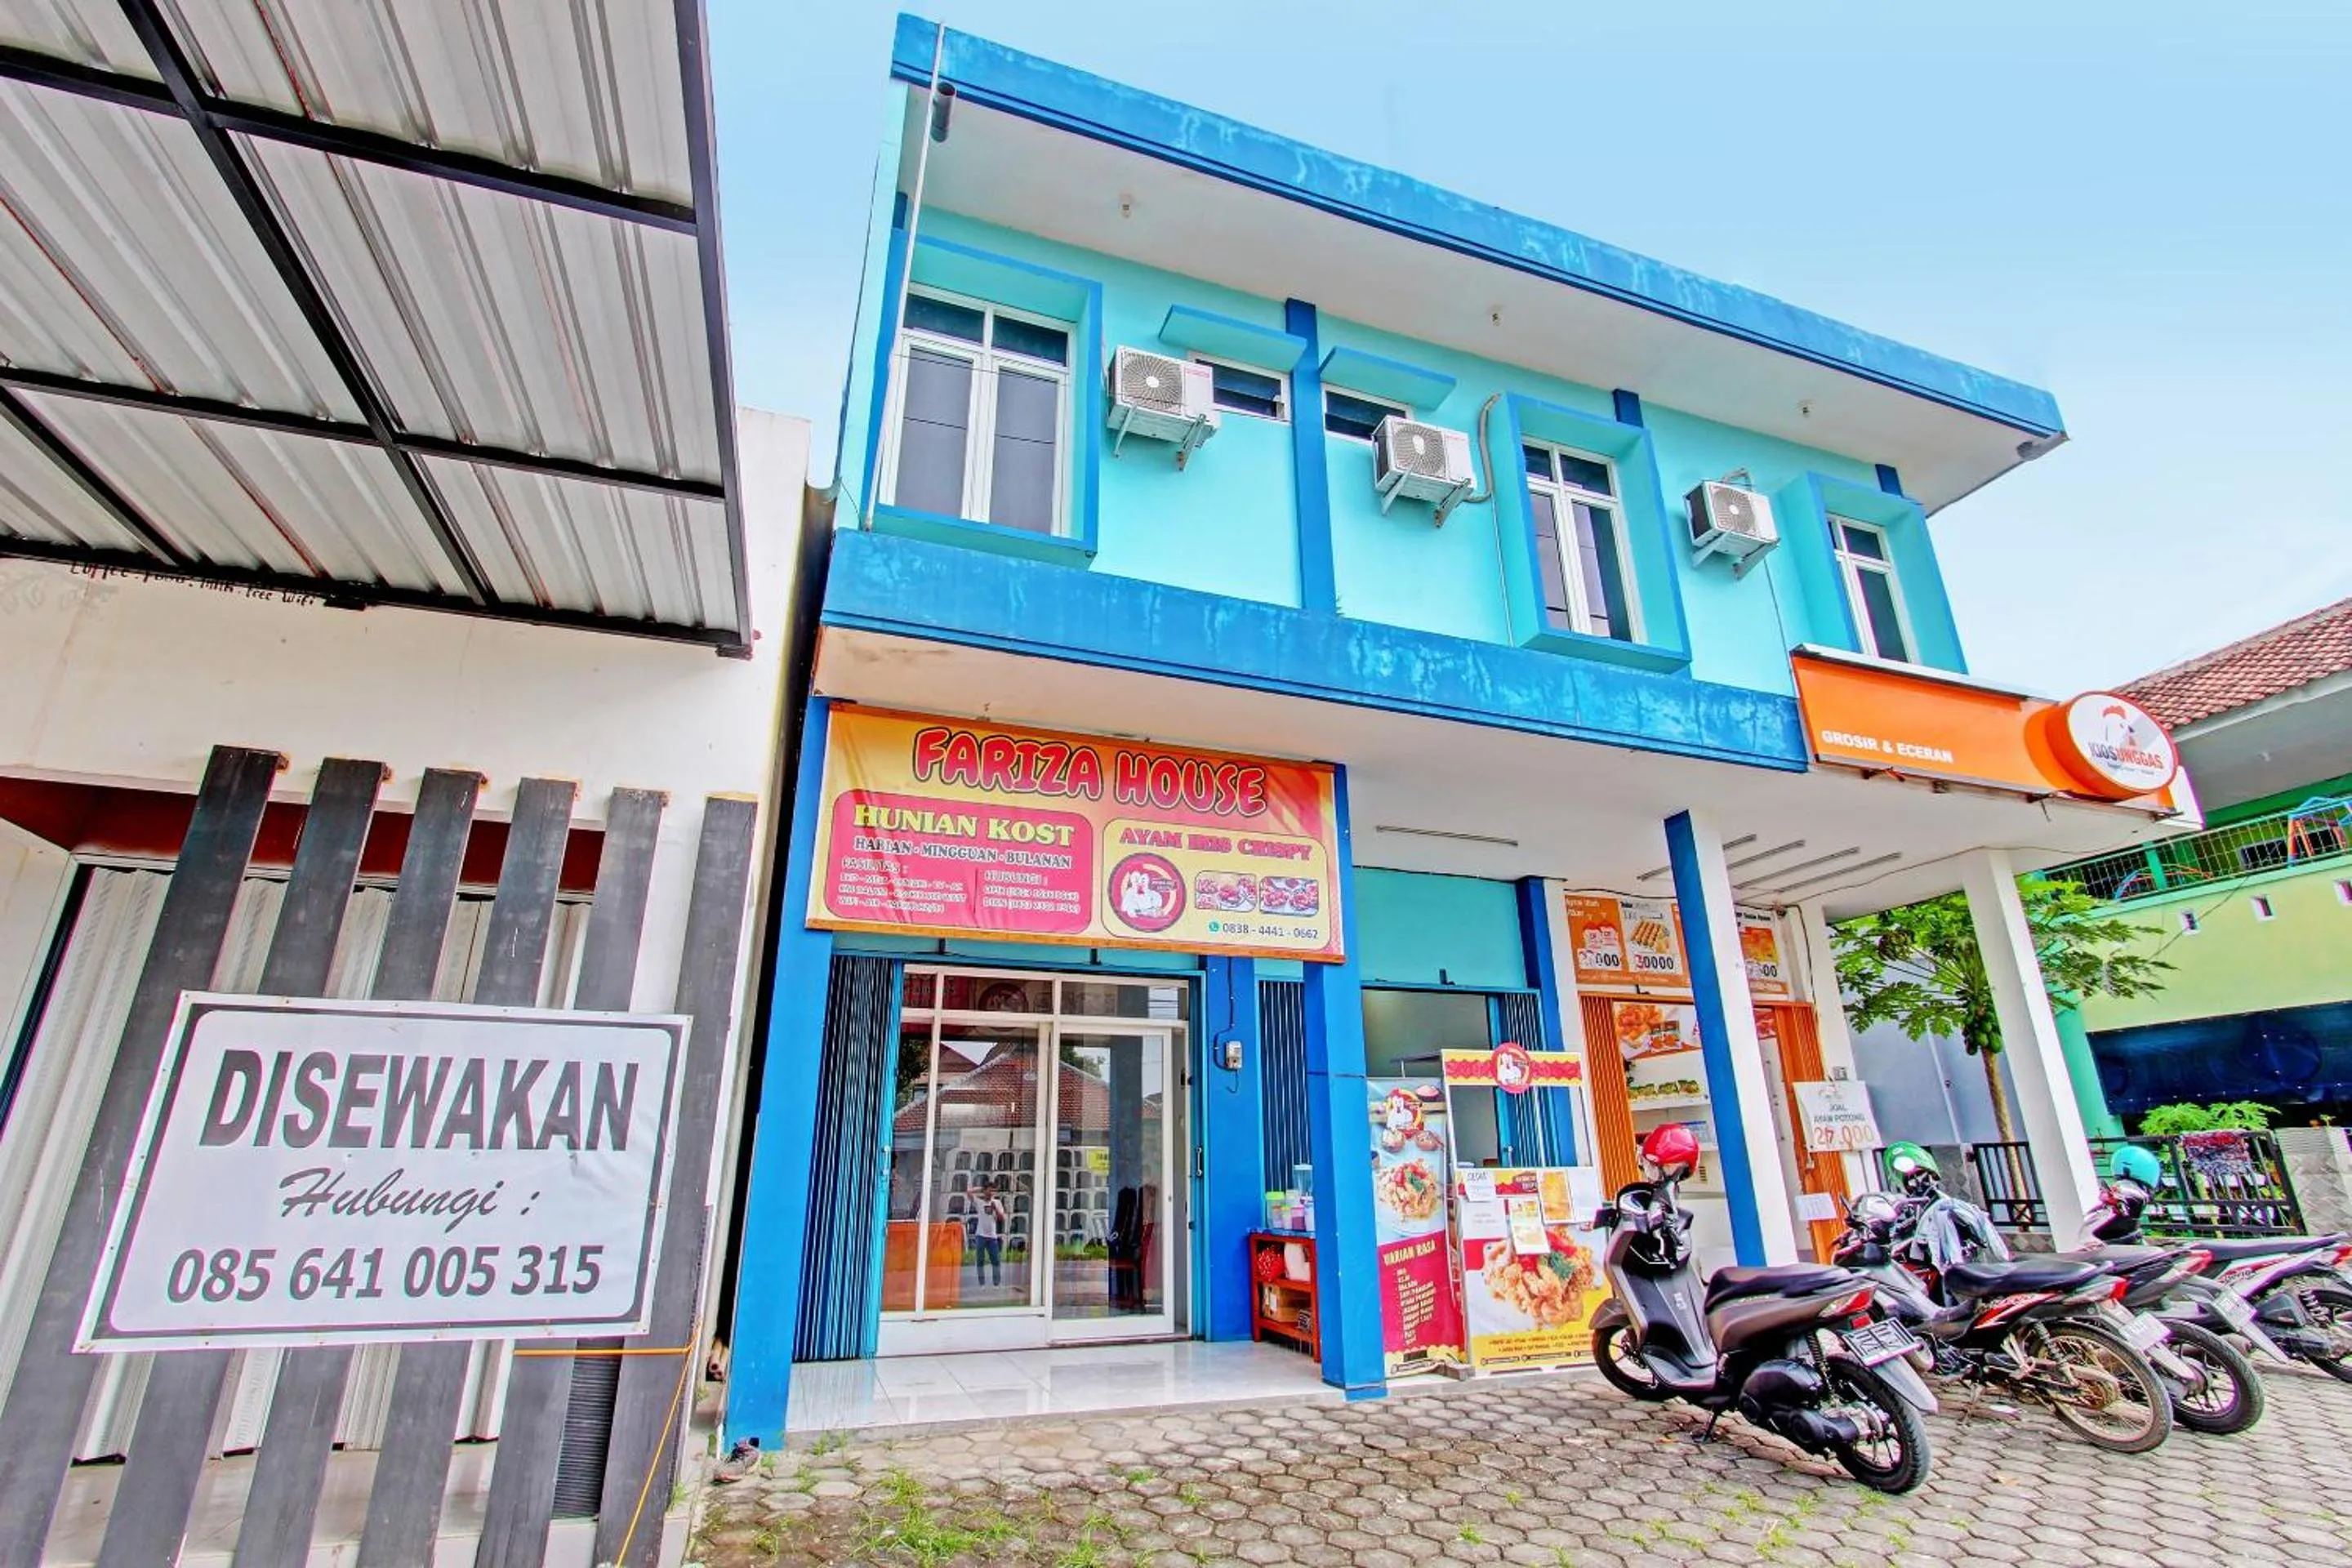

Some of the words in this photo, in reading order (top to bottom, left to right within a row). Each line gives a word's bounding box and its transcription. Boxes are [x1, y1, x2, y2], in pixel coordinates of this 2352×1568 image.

[1821, 730, 1879, 751] GROSIR
[1882, 740, 1894, 754] &
[1896, 742, 1954, 764] ECERAN
[913, 726, 1103, 802] FARIZA
[1113, 751, 1267, 817] HOUSE
[853, 804, 978, 837] HUNIAN
[987, 817, 1075, 847] KOST
[1120, 826, 1182, 849] AYAM
[854, 836, 912, 854] HARIAN
[920, 843, 996, 862] MINGGUAN
[1005, 851, 1071, 869] BULANAN
[1633, 954, 1674, 970] 30000
[199, 1049, 640, 1152] DISEWAKAN
[279, 1168, 504, 1233] Hubungi
[167, 1248, 276, 1303] 085
[288, 1247, 384, 1299] 641
[403, 1245, 500, 1297] 005
[511, 1245, 604, 1294] 315
